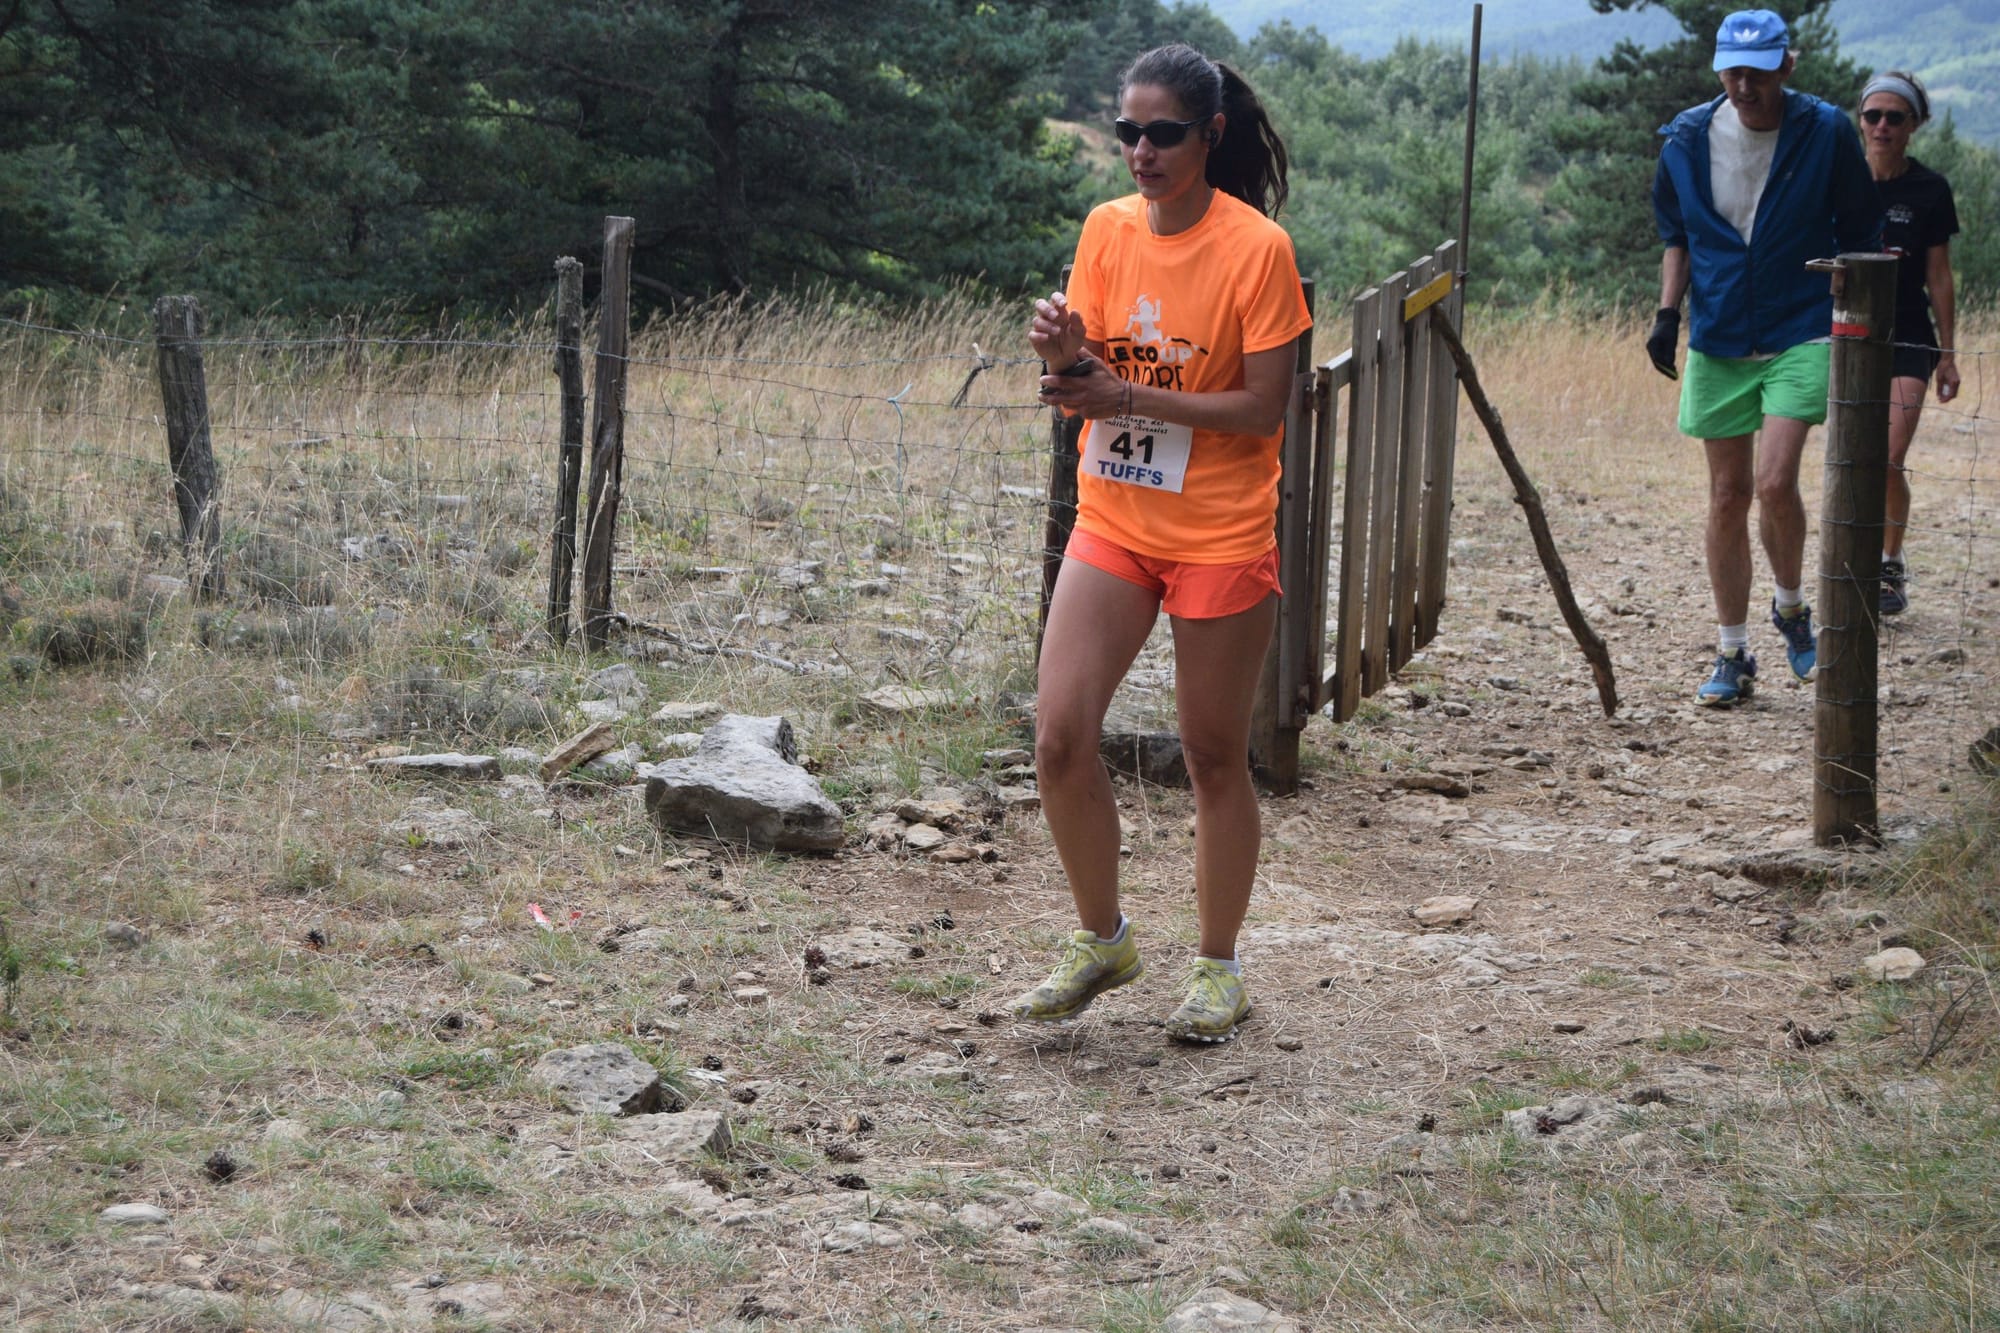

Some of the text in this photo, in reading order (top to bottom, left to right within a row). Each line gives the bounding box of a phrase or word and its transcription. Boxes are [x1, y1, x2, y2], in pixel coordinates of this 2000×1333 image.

[1107, 346, 1193, 364] LE COUP
[1109, 431, 1154, 465] 41
[1098, 460, 1164, 486] TUFF'S
